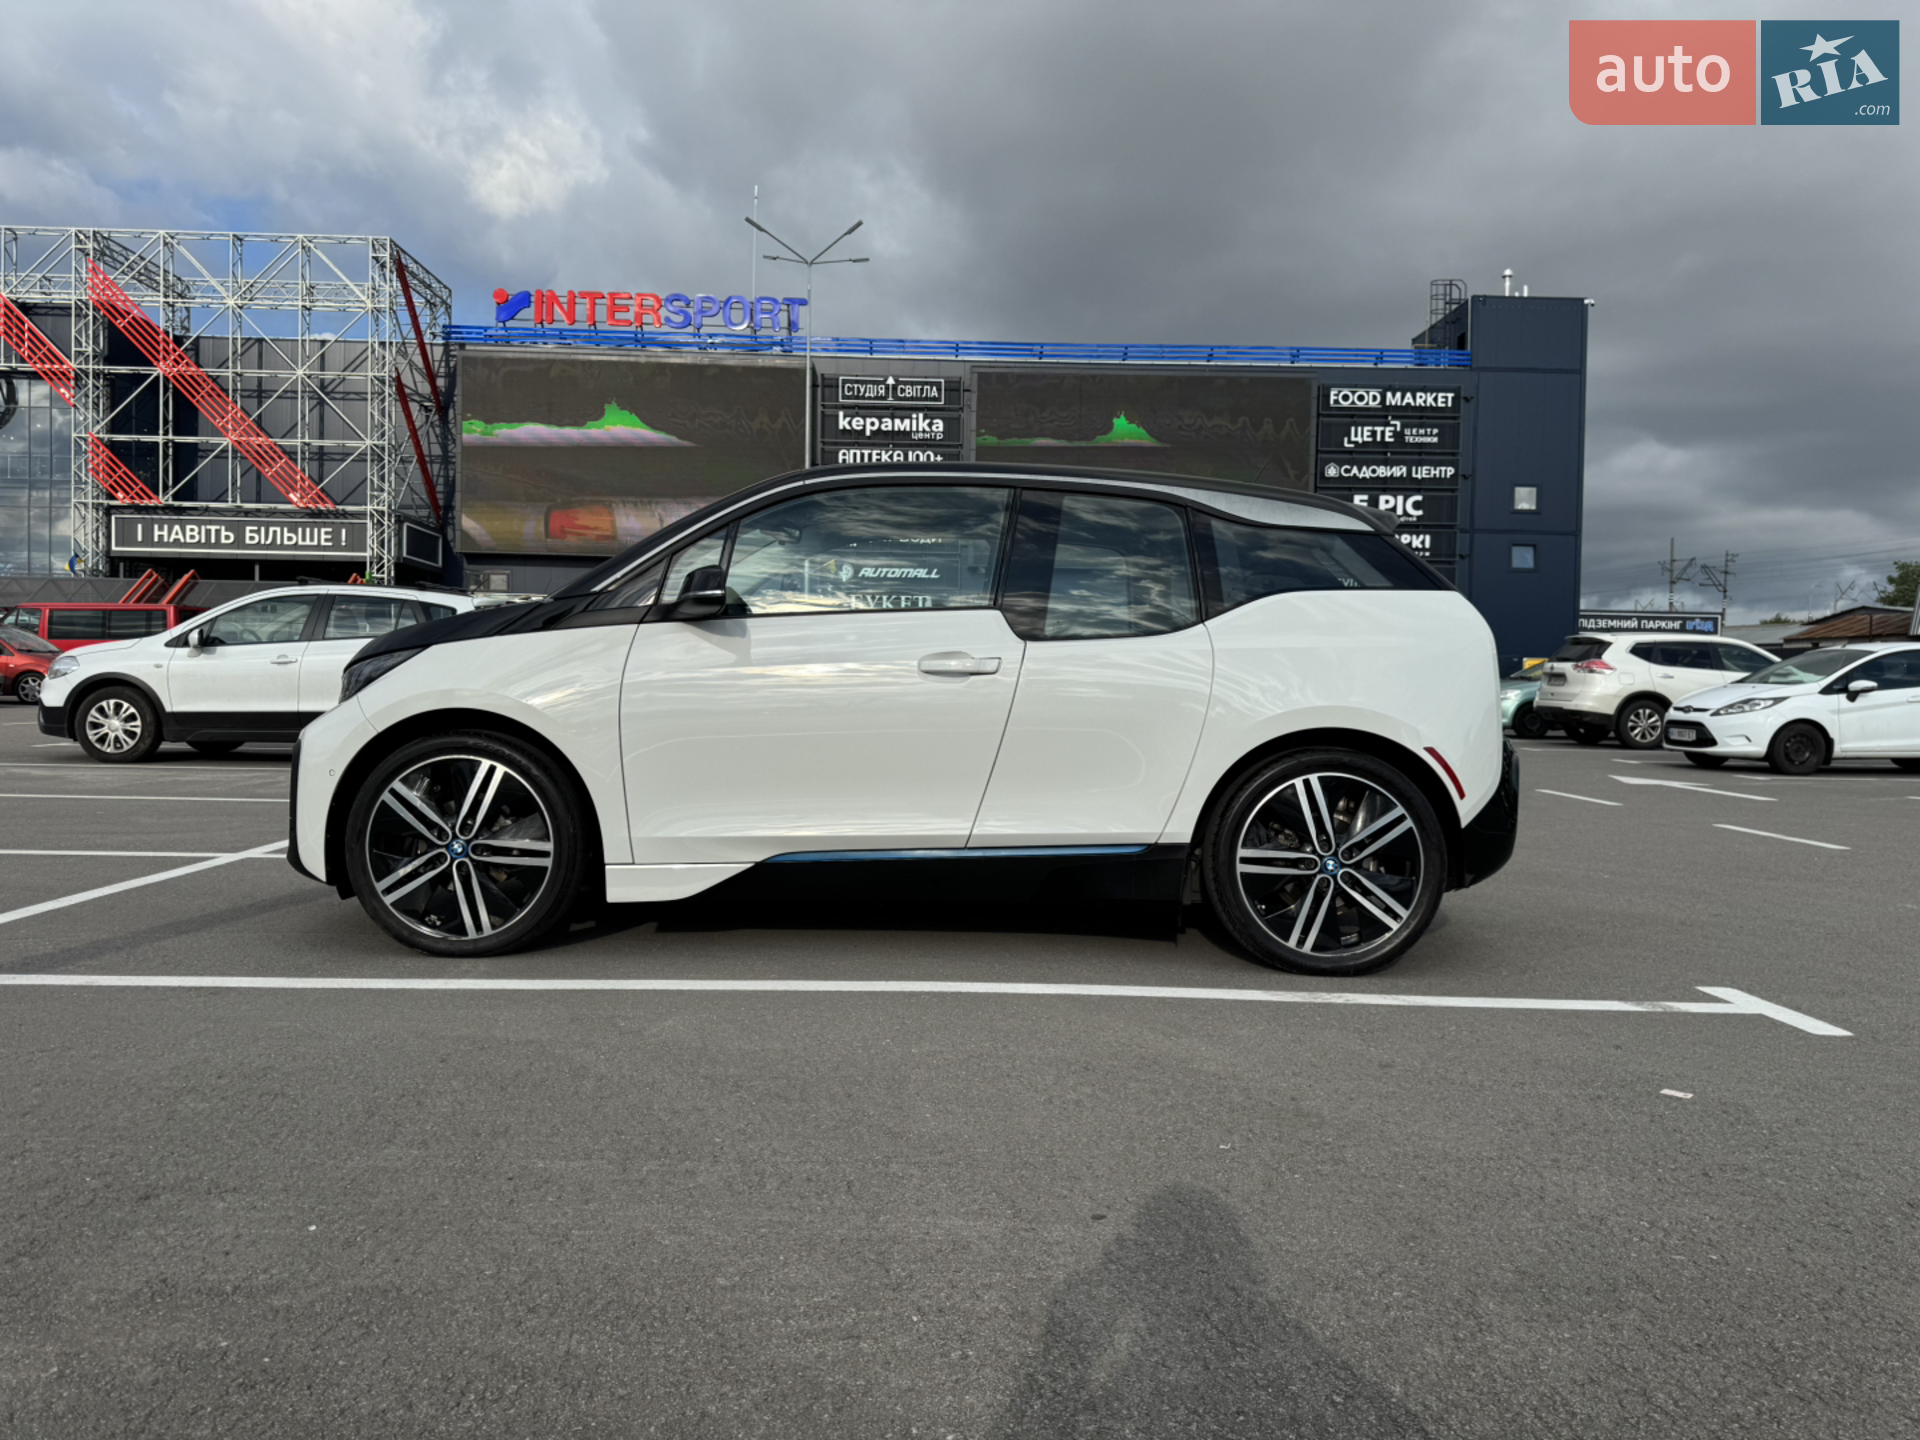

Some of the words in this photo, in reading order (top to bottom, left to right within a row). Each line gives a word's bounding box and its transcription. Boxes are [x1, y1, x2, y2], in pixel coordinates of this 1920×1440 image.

[533, 288, 808, 332] INTERSPORT
[844, 383, 885, 397] СТУДІЯ
[897, 385, 939, 398] СВІТЛА
[1330, 390, 1382, 407] FOOD
[1386, 392, 1455, 408] MARKET
[1350, 426, 1395, 443] ЦЕТЕ
[838, 449, 904, 464] АПТЕКА
[1340, 465, 1407, 479] САДОВИЙ
[1411, 466, 1455, 480] ЦЕНТР
[153, 525, 235, 544] НАВІТЬ
[244, 526, 333, 546] БІЛЬШЕ
[858, 567, 940, 578] AUTOMALL
[1578, 617, 1638, 630] ПІДЗЕМНИЙ
[1641, 620, 1682, 630] ПАРКІНГ
